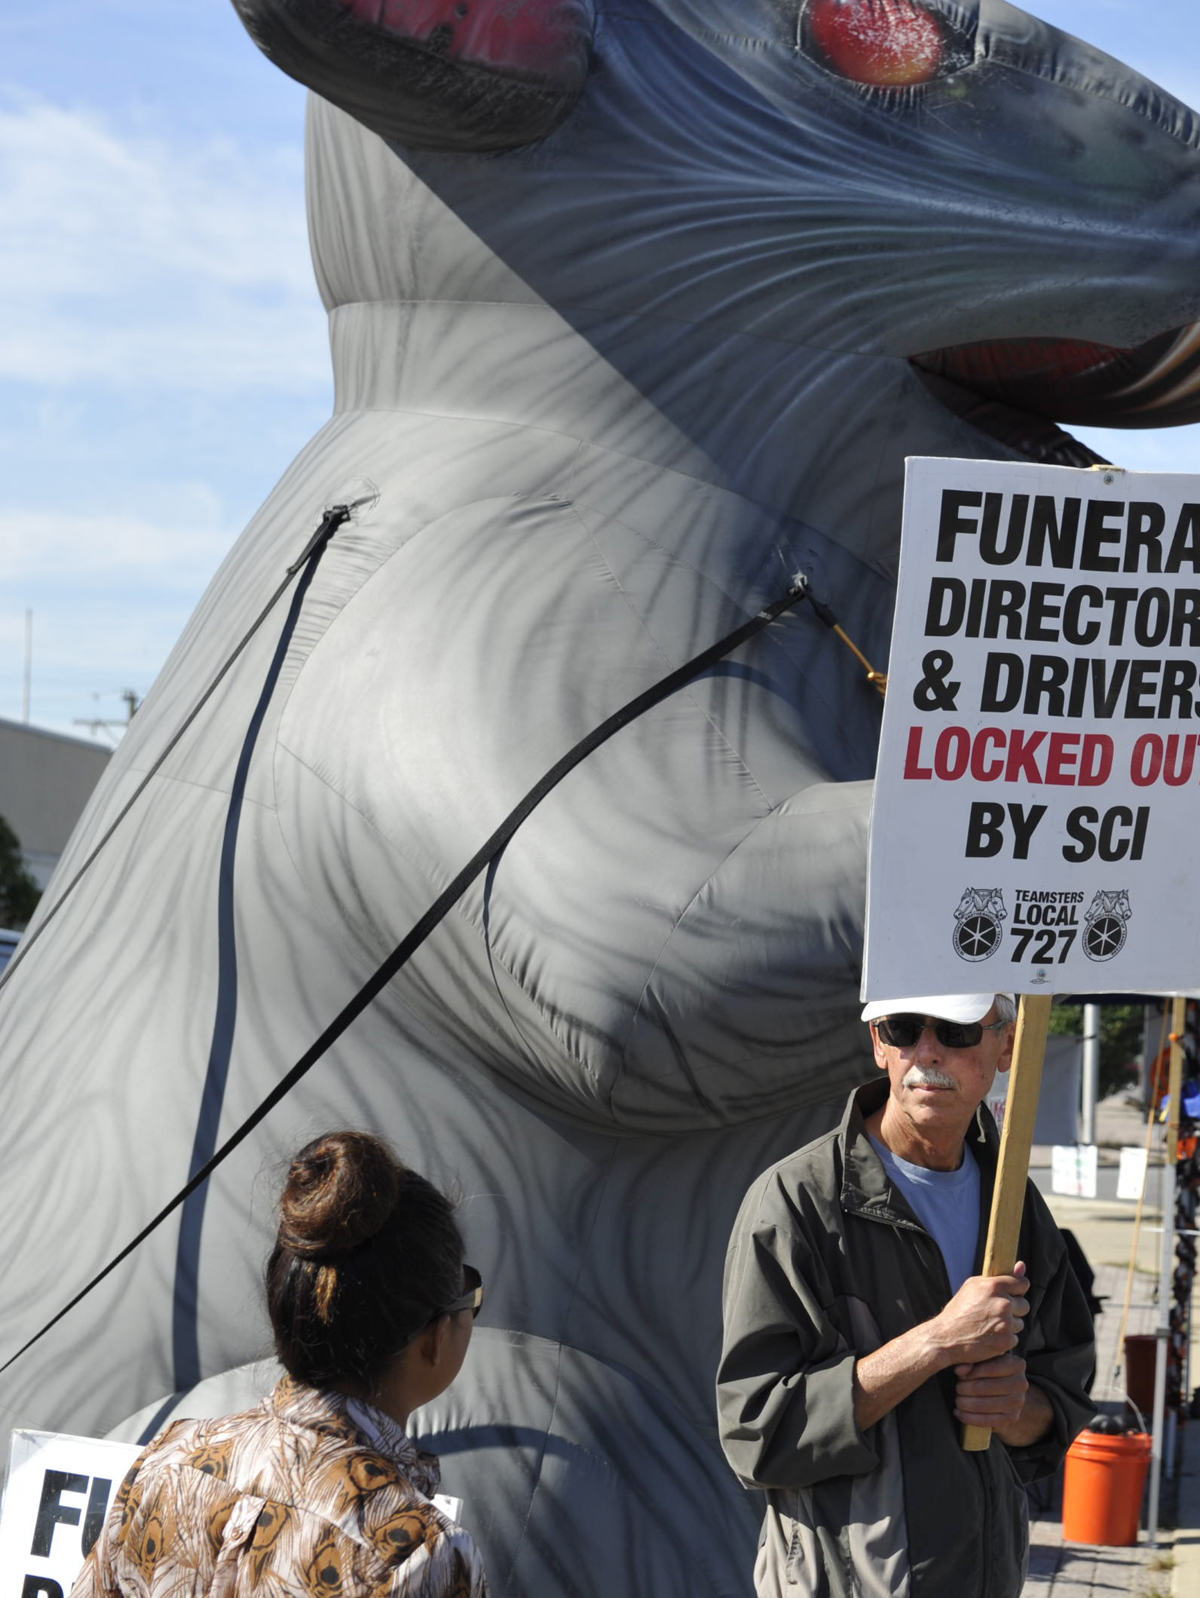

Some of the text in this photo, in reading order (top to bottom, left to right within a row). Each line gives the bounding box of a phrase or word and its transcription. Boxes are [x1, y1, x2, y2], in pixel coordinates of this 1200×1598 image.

[913, 650, 961, 711] &
[904, 726, 1115, 786] LOCKED
[965, 802, 1150, 862] BY SCI
[1013, 903, 1079, 926] LOCAL
[1015, 890, 1084, 903] TEAMSTERS
[1010, 928, 1078, 964] 727
